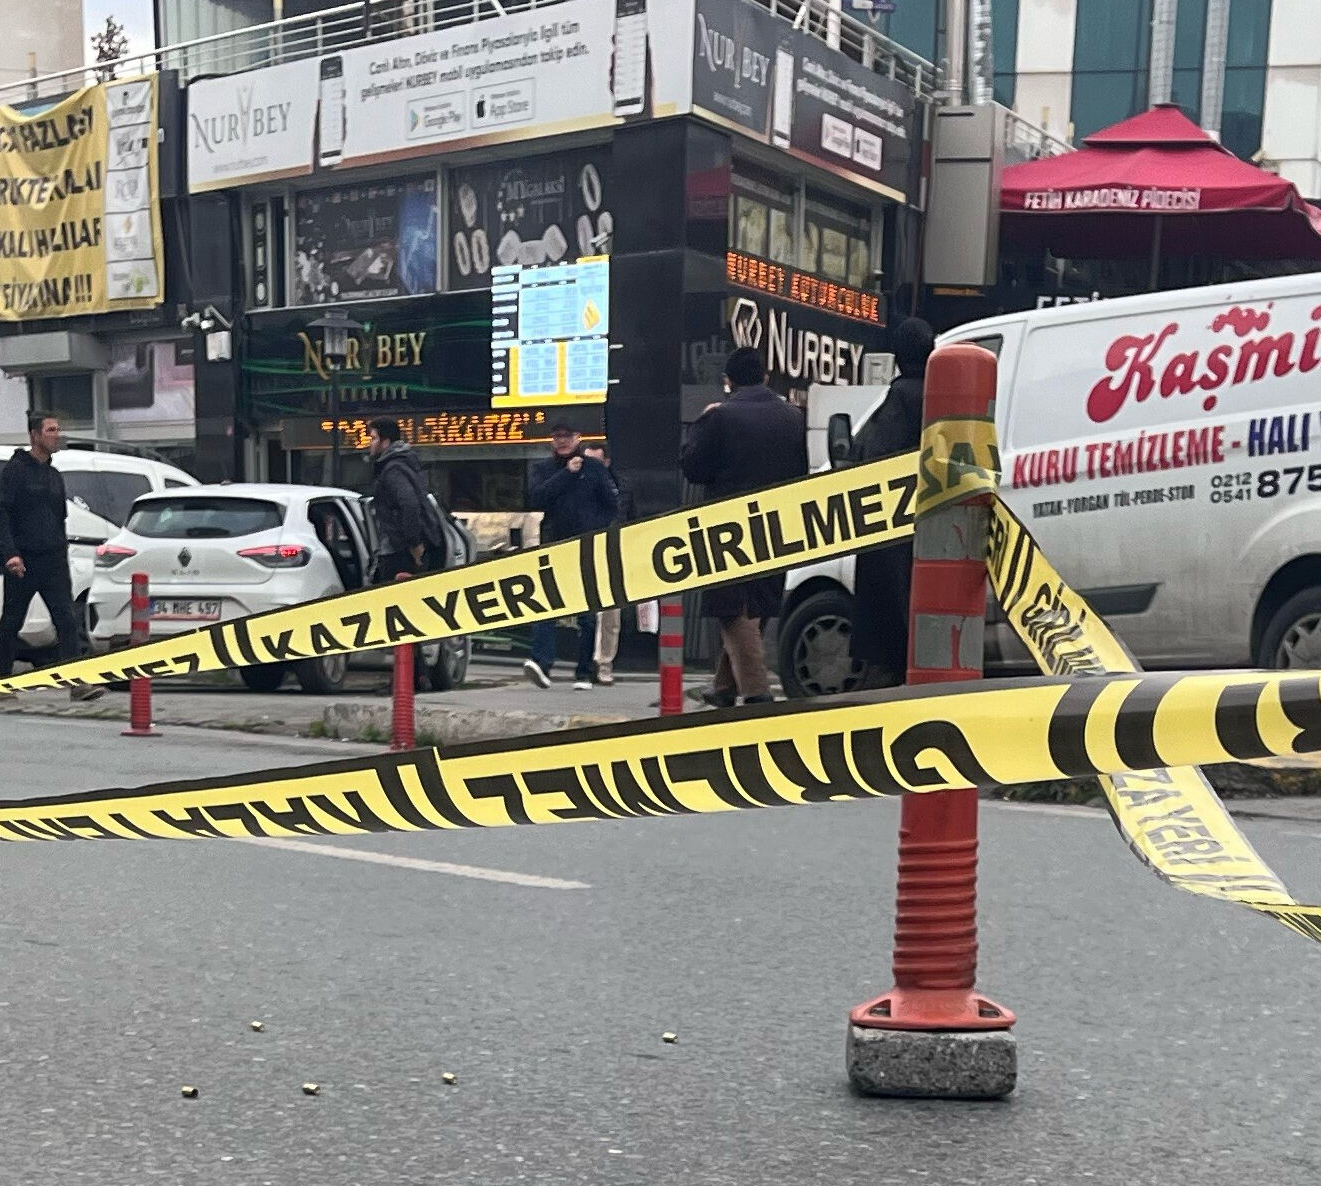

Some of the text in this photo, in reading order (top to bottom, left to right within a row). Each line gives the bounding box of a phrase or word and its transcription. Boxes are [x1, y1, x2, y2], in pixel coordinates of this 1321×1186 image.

[189, 101, 291, 154] NURBEY
[298, 331, 426, 380] NRBEY
[1012, 443, 1080, 489] KURU
[1084, 425, 1225, 480] TEMİZLEME
[1248, 413, 1310, 457] HALI
[261, 474, 918, 661] KAZA YERİ GİRİLMEZ
